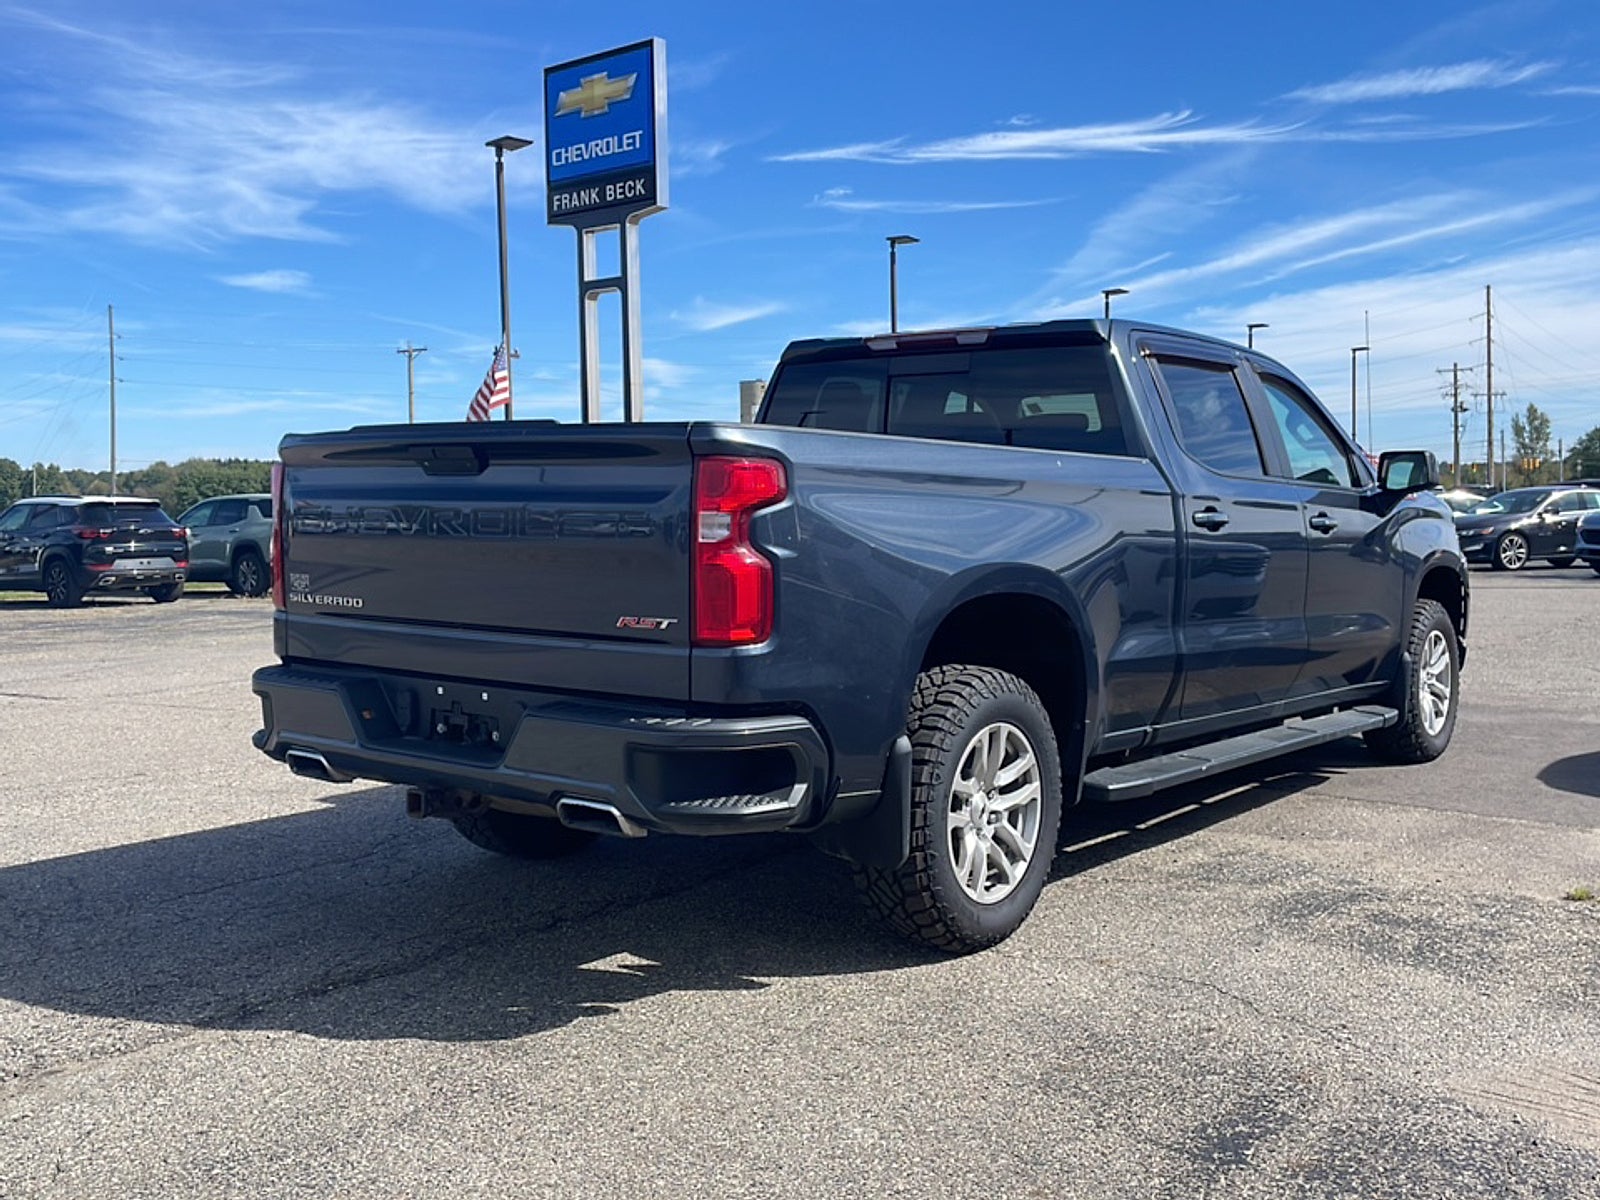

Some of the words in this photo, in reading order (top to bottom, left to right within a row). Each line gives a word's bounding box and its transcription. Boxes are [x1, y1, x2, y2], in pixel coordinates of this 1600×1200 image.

[551, 130, 643, 167] CHEVROLET
[553, 187, 600, 211] FRANK
[606, 178, 646, 201] BECK
[289, 592, 363, 608] SILVERADO
[616, 616, 678, 629] RST
